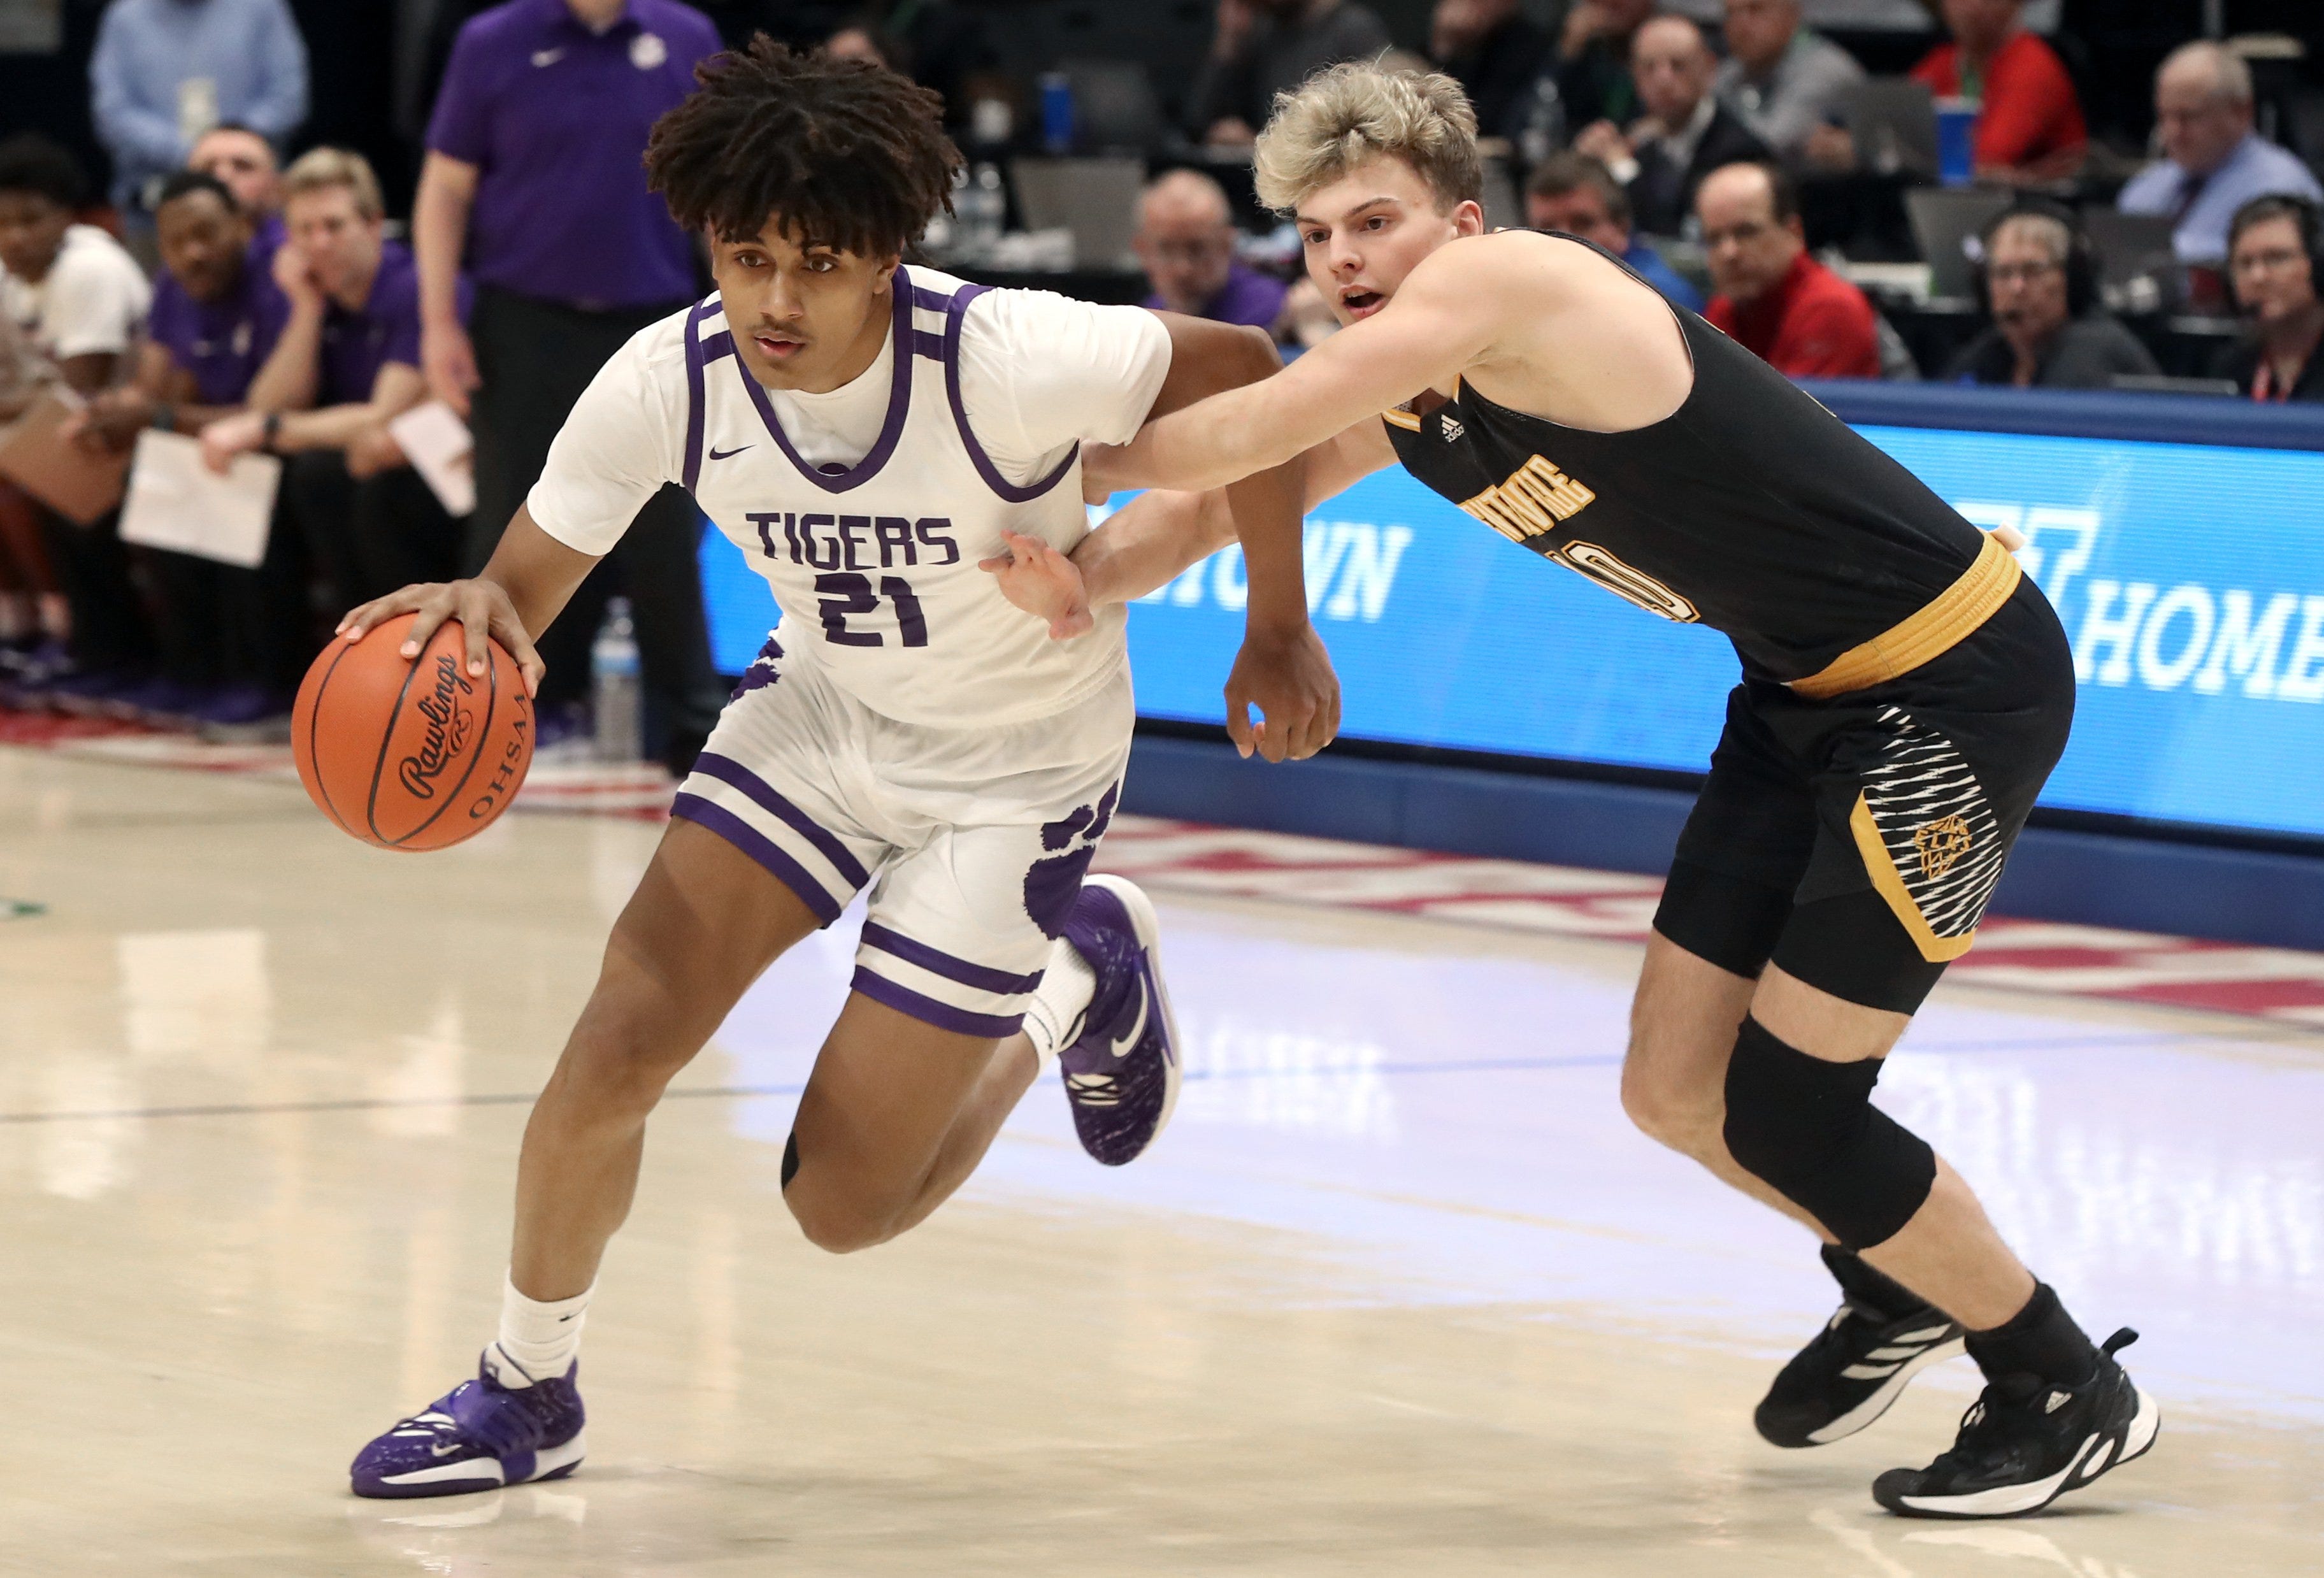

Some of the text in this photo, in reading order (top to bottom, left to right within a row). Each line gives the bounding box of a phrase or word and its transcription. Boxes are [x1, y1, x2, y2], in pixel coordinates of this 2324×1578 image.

[745, 512, 960, 571] TIGERS
[814, 573, 929, 647] 21
[2072, 578, 2324, 703] HOME
[399, 652, 473, 800] Rawlings
[469, 693, 527, 819] OHSAA
[1914, 828, 1973, 851] ELKS
